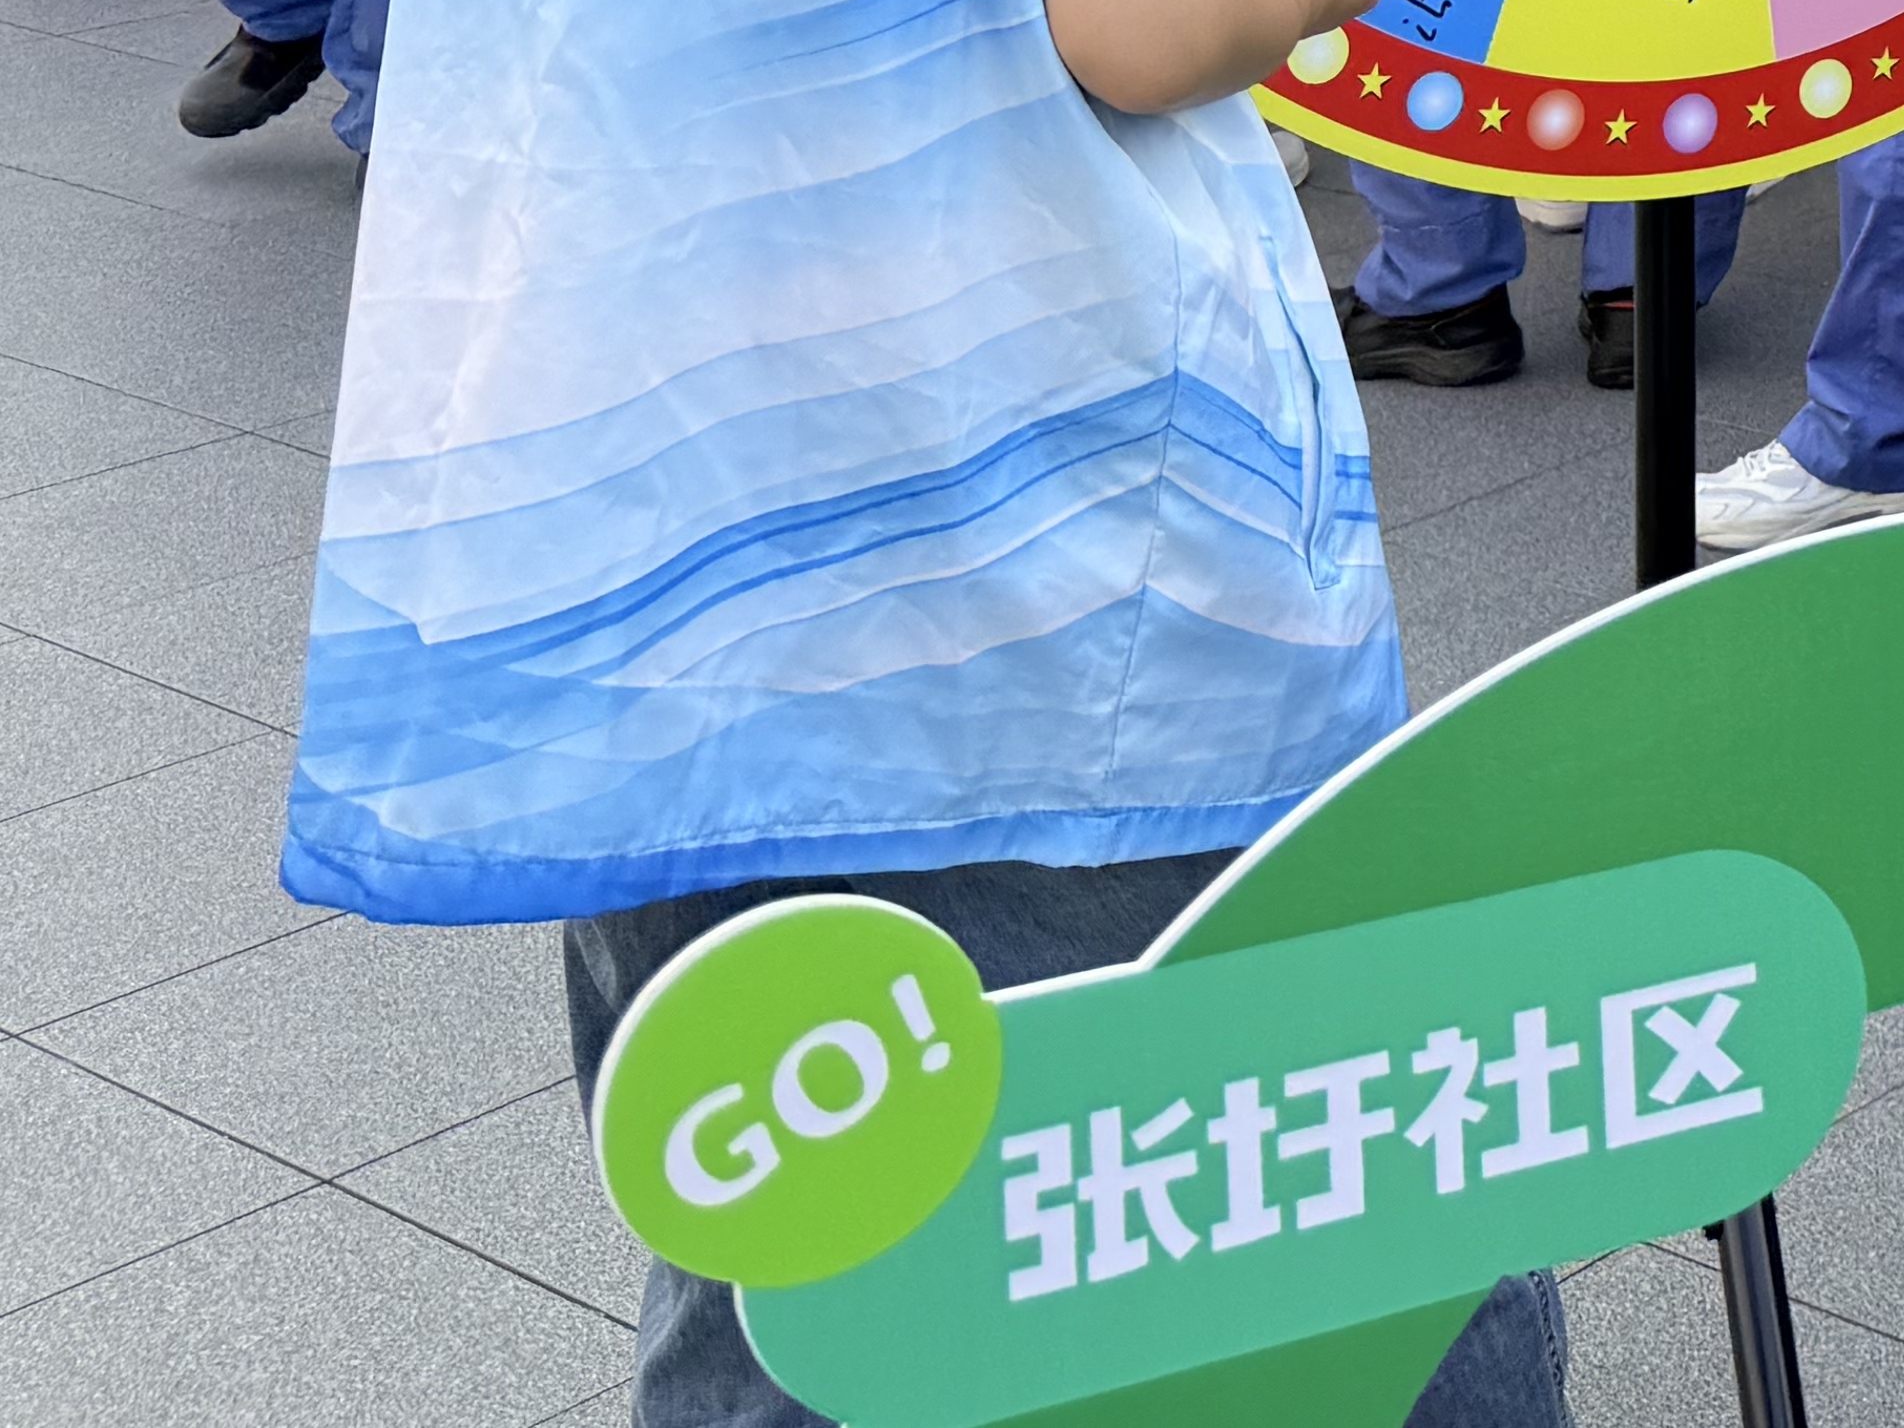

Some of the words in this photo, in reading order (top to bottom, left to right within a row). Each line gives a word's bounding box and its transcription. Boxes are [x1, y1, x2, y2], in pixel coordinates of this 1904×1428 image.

[663, 973, 953, 1210] GO!
[1003, 961, 1765, 1303] 张圩社区
